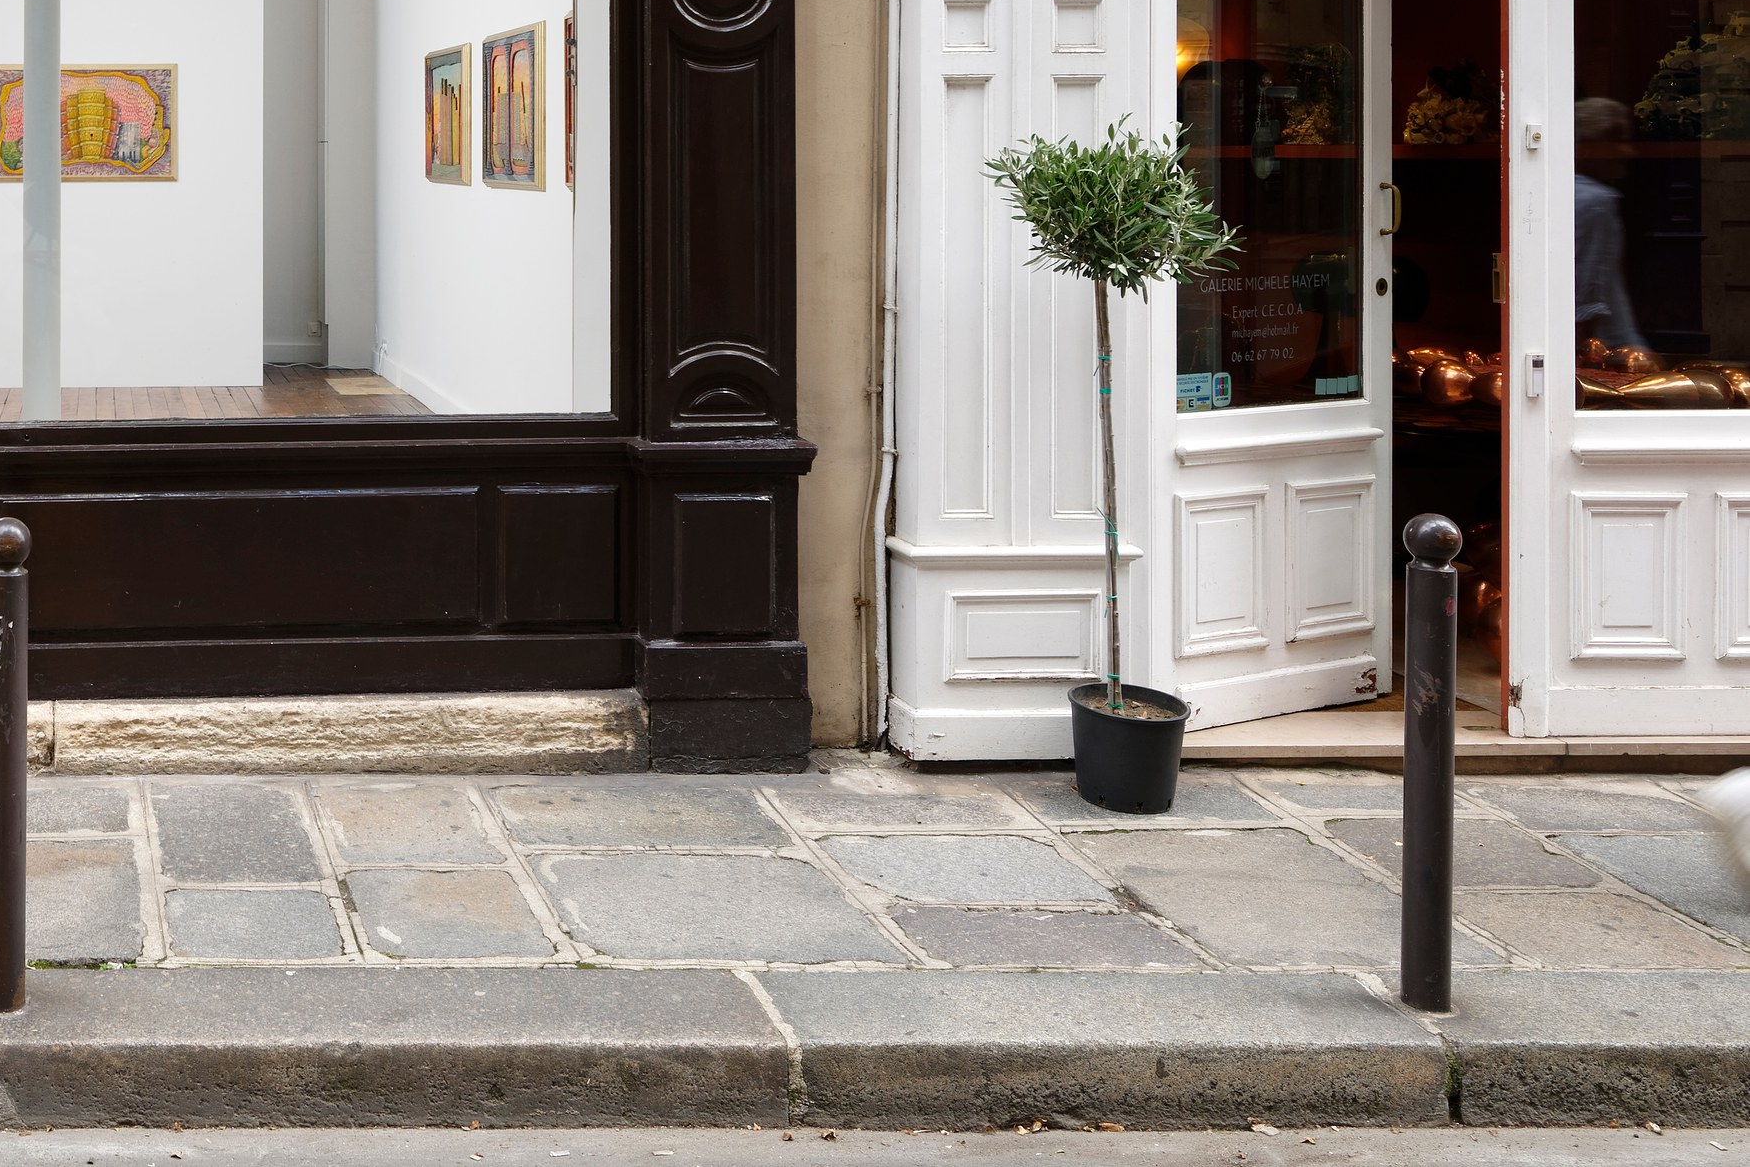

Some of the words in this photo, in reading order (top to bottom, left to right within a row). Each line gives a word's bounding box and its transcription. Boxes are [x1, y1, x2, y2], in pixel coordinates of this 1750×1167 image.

[1200, 277, 1242, 293] GALERIE
[1245, 275, 1289, 291] MICHELE
[1292, 273, 1330, 288] HAYEM
[1232, 305, 1258, 323] Expert
[1231, 351, 1243, 362] 06
[1245, 350, 1255, 362] 62
[1257, 349, 1267, 361] 67
[1270, 349, 1280, 360] 79
[1282, 348, 1294, 359] 02
